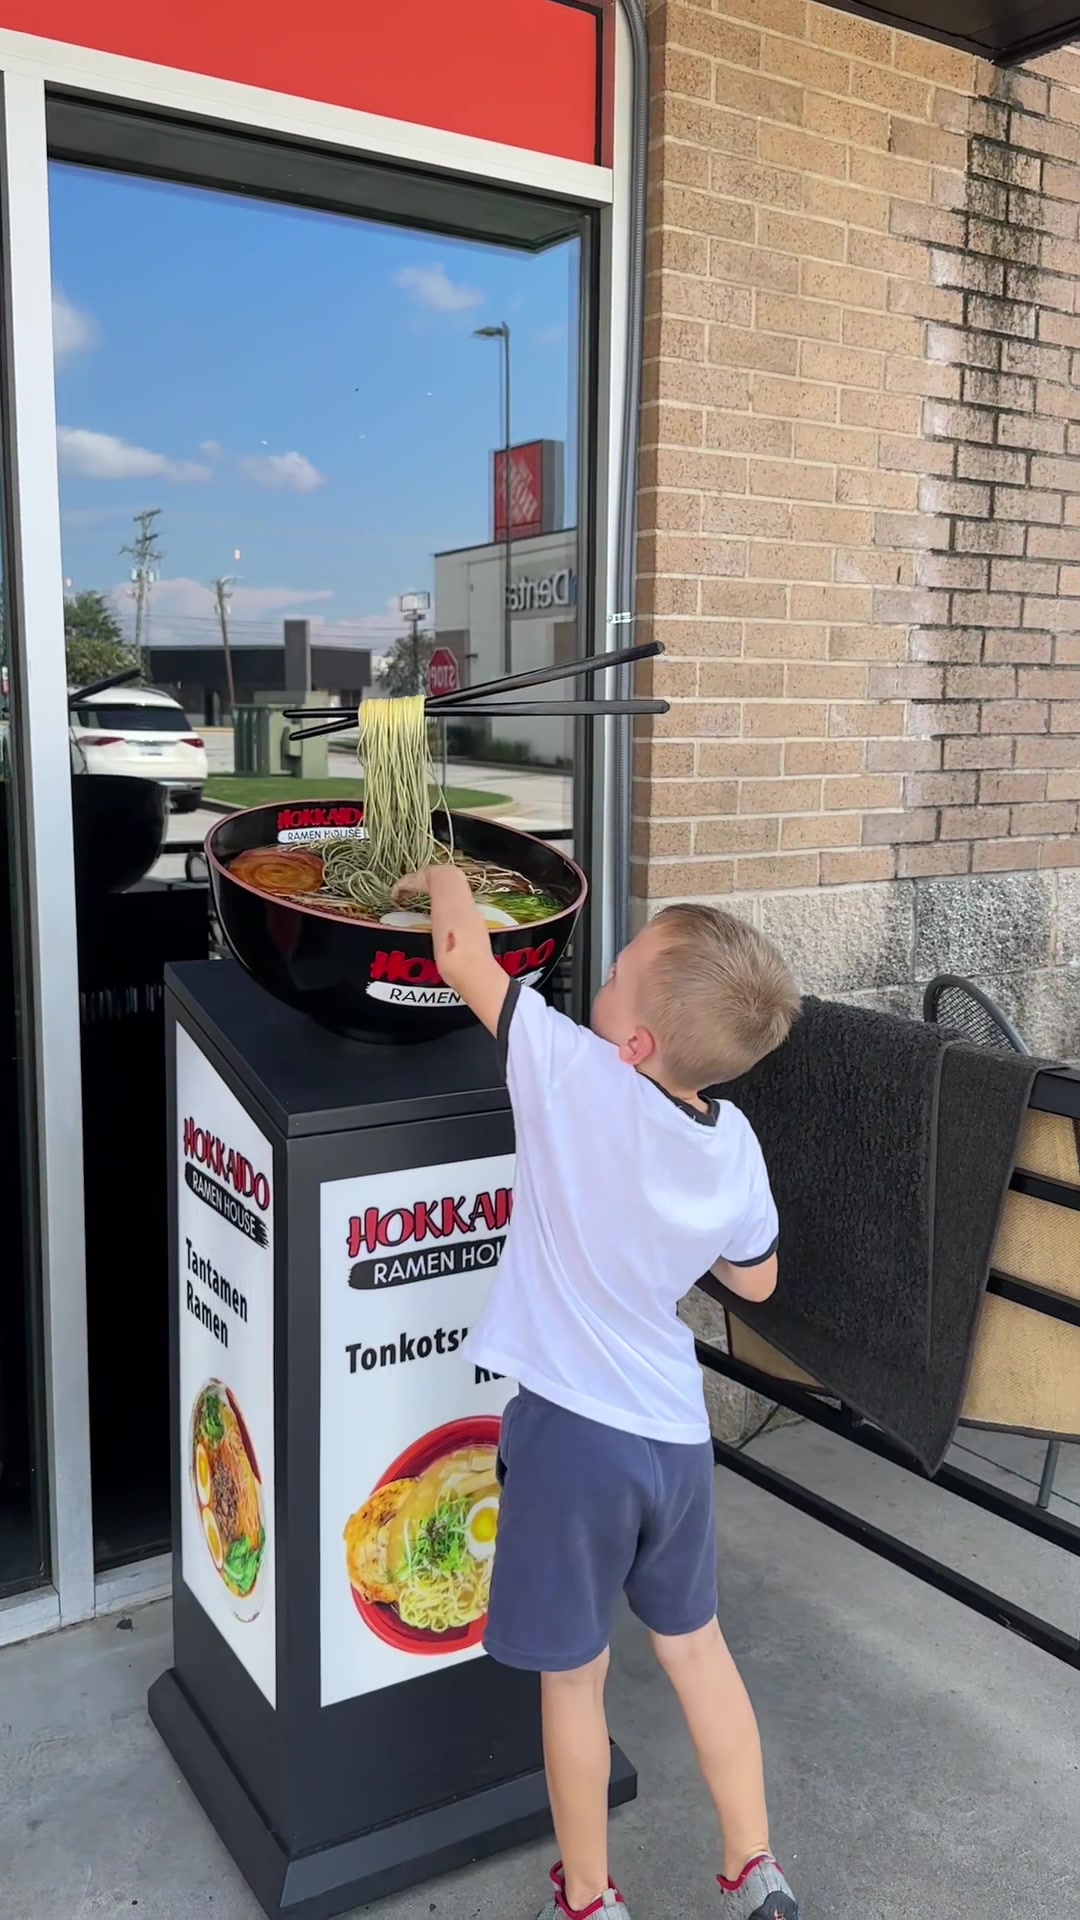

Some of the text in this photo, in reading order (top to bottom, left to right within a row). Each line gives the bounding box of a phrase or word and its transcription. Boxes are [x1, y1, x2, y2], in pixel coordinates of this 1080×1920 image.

[277, 807, 364, 830] HOKKAID
[287, 828, 362, 841] RAMEN HOUSE
[389, 988, 461, 1004] RAMEN
[183, 1116, 270, 1211] HOKKAIDO
[192, 1171, 257, 1238] RAMEN HOUSE
[346, 1187, 514, 1258] HOKKAI
[185, 1237, 248, 1323] Tantamen
[374, 1249, 455, 1285] RAMEN
[186, 1280, 228, 1348] Ramen
[345, 1327, 468, 1374] Tonkots
